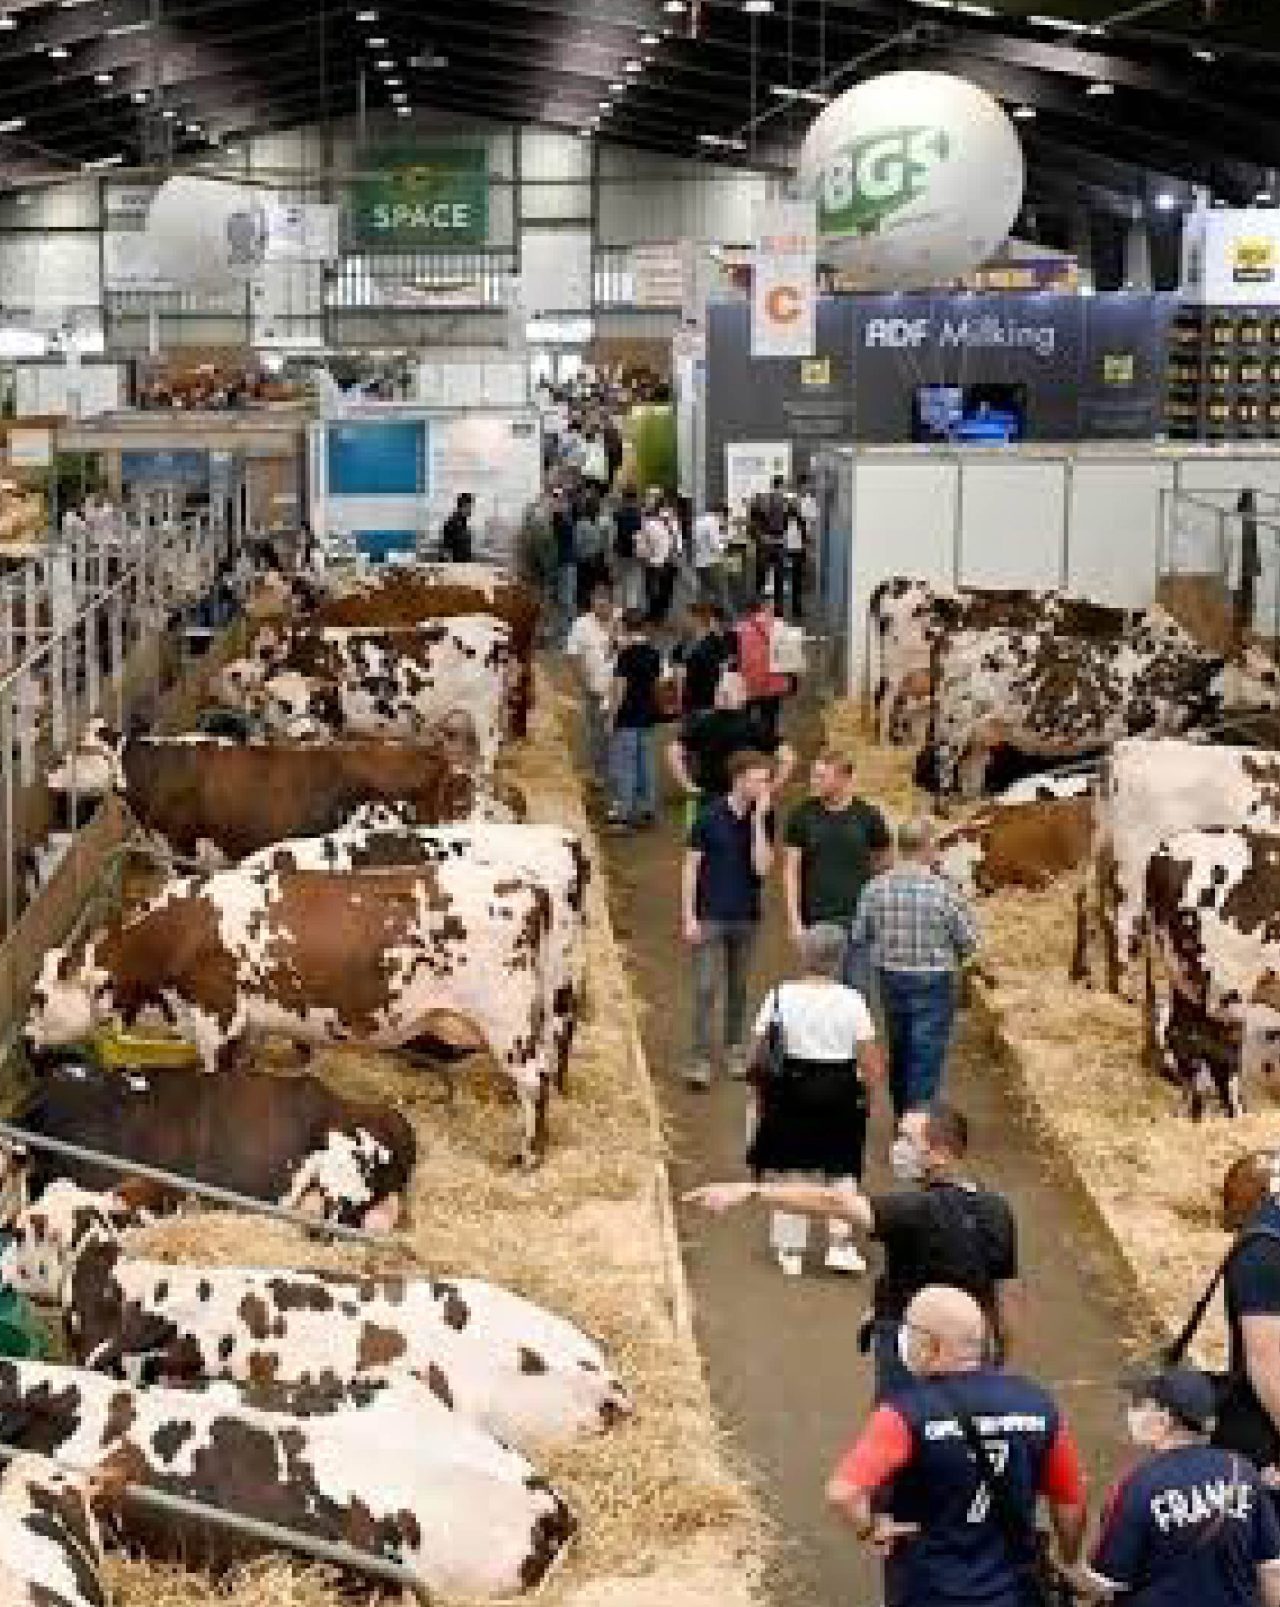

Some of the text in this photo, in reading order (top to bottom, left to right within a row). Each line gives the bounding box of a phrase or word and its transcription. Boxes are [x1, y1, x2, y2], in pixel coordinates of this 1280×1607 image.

[373, 203, 470, 228] SPACE
[764, 285, 801, 324] C
[939, 315, 1055, 356] Milking
